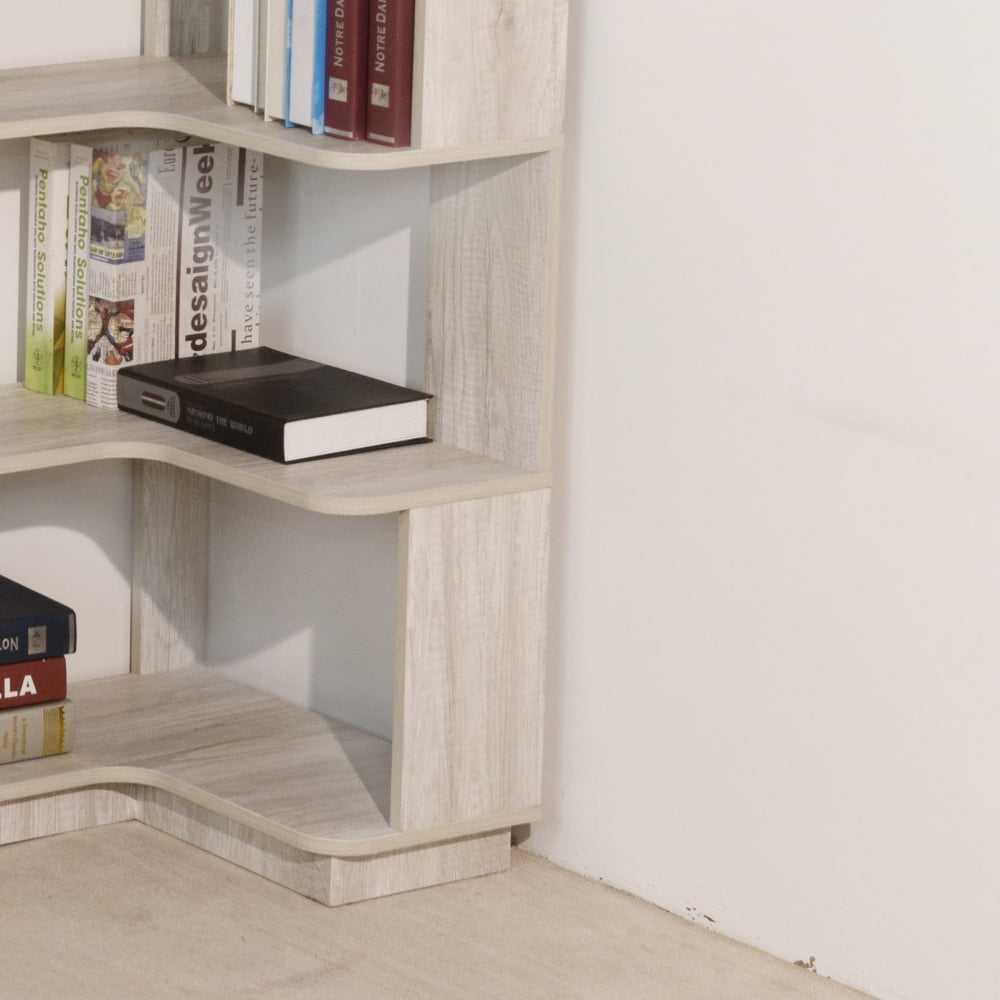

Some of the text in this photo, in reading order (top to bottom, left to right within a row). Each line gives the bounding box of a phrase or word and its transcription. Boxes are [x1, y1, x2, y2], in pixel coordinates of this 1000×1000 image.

[334, 20, 345, 67] NOTRE
[374, 26, 386, 72] NOTRE
[37, 168, 48, 244] Pentaho
[75, 175, 90, 339] Pentaho Solutions
[185, 144, 214, 358] desaignWeek
[243, 225, 256, 254] the
[36, 250, 47, 332] Solutions
[245, 259, 255, 298] seen
[240, 304, 254, 344] have
